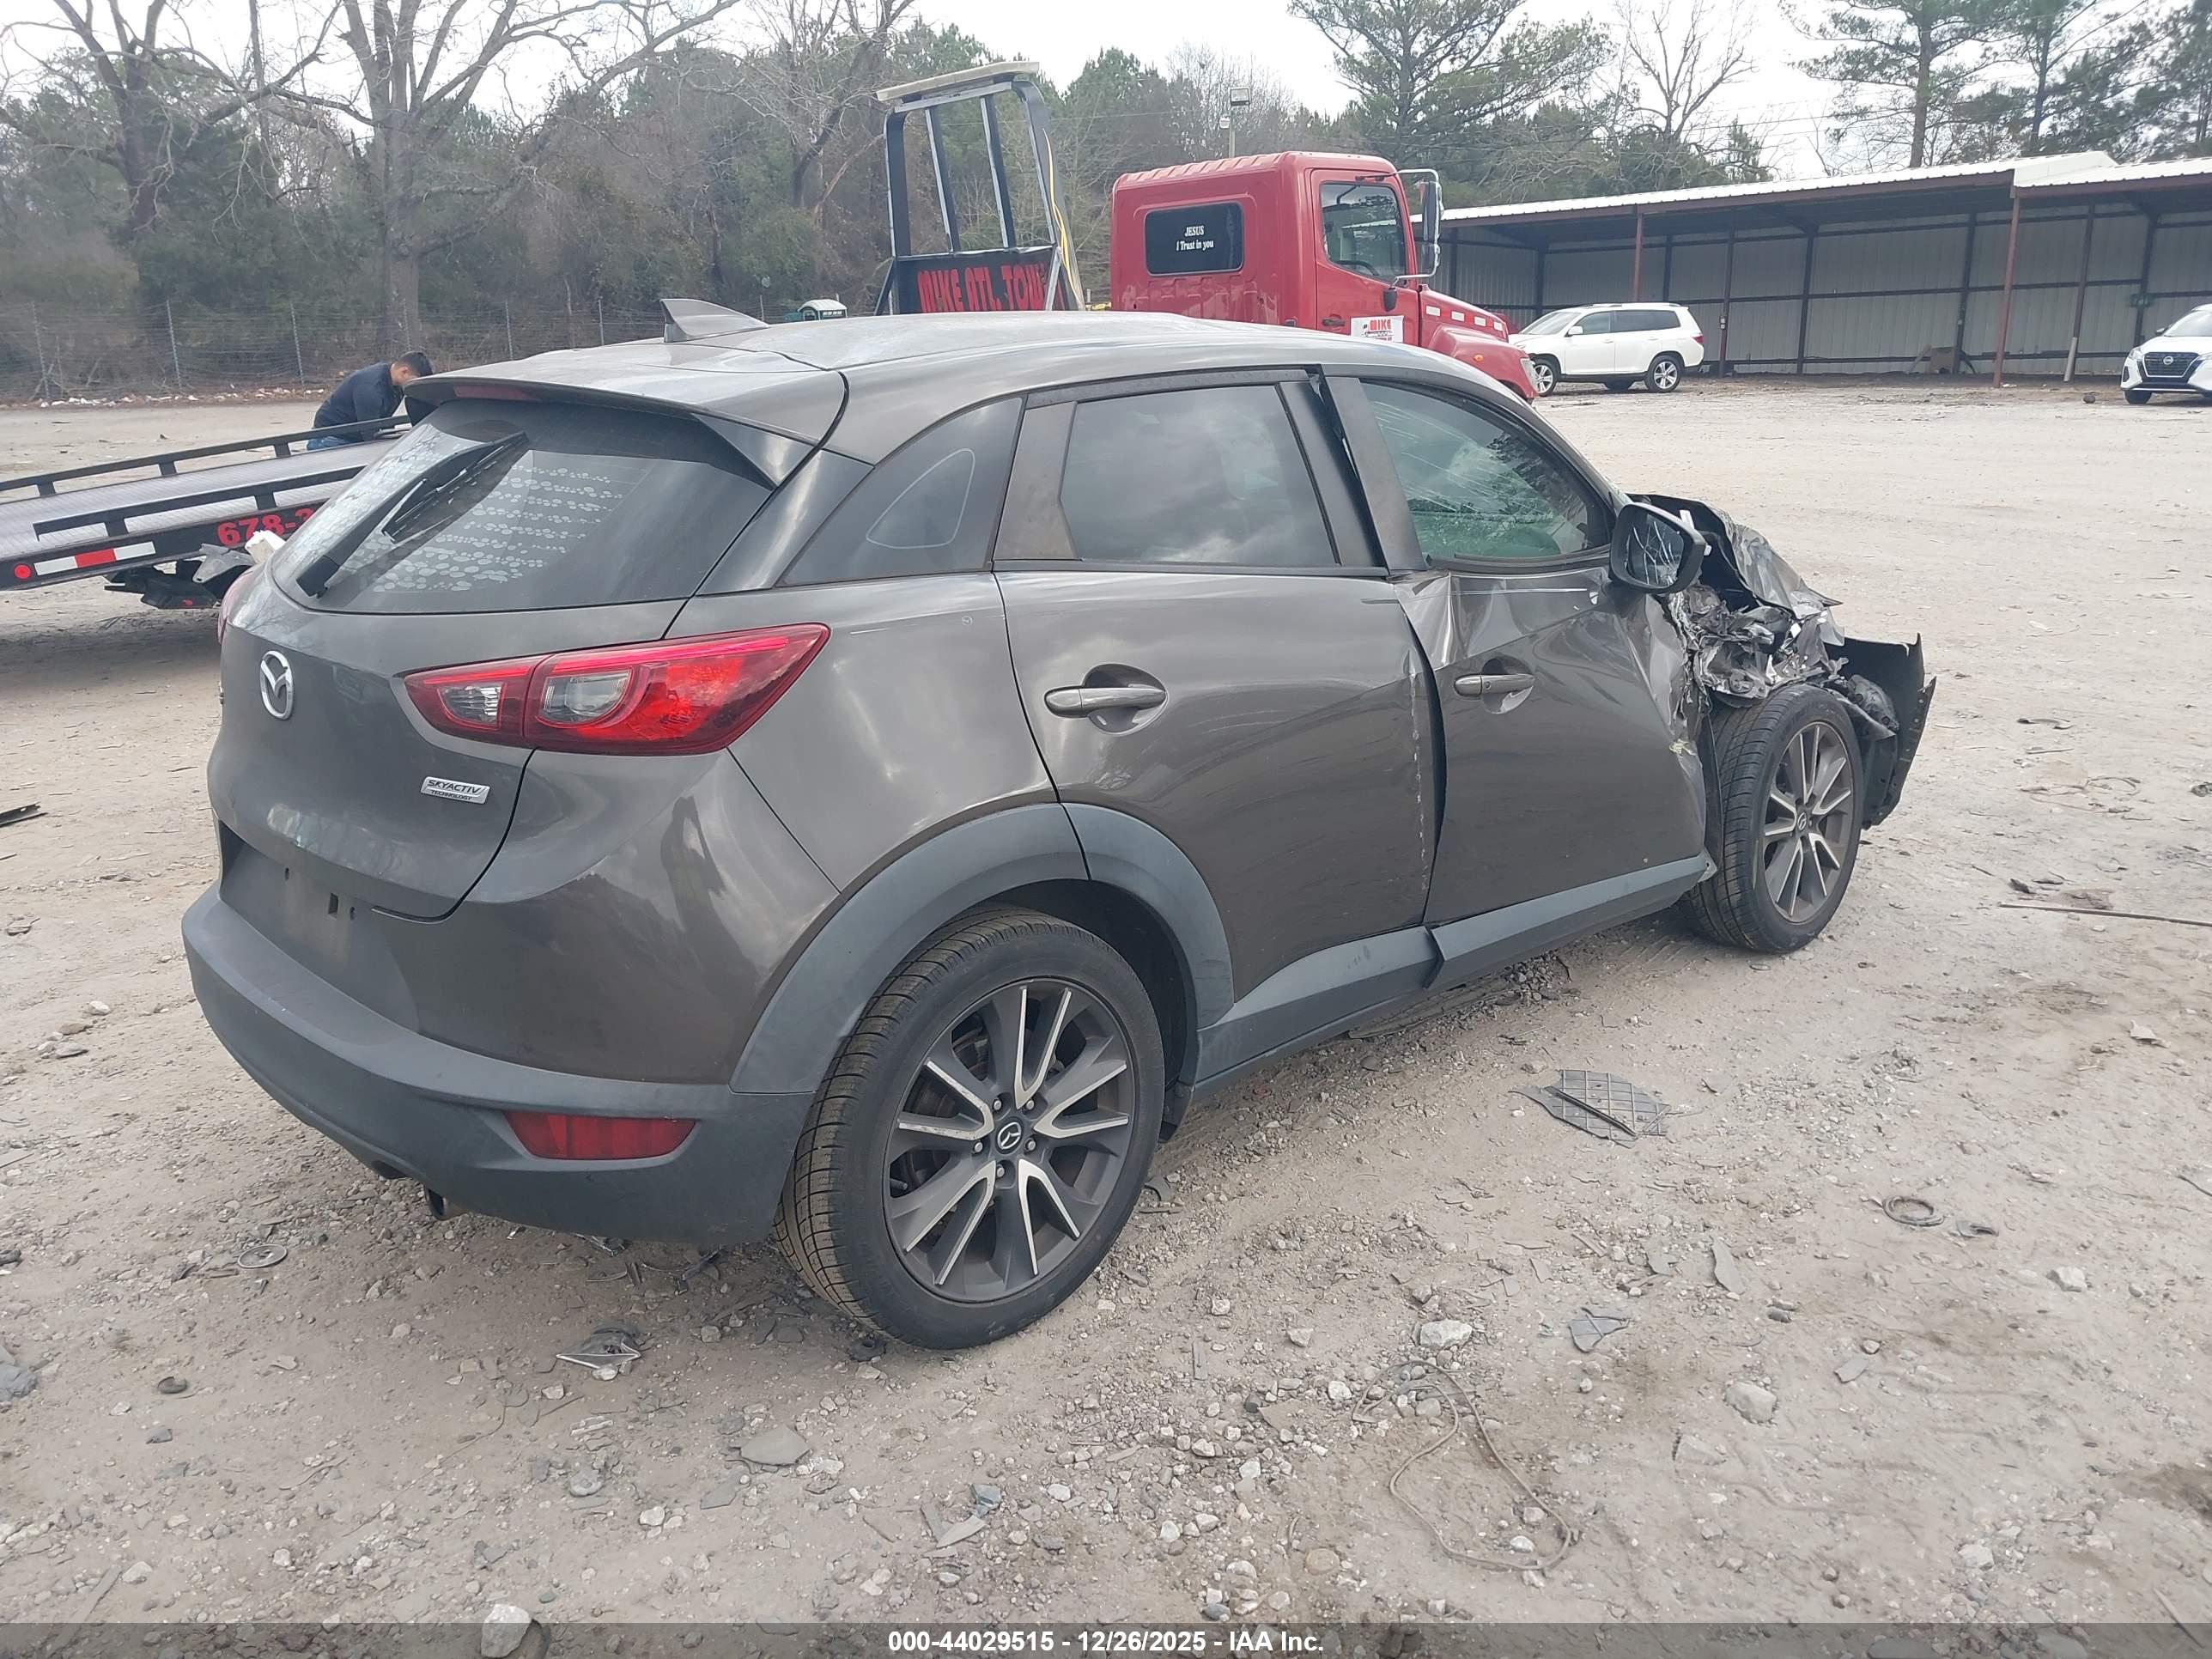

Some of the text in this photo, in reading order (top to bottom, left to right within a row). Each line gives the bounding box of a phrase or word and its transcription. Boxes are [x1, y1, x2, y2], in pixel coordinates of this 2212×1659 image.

[1184, 225, 1205, 237] JESUS
[1176, 239, 1214, 251] I Trust in you
[917, 268, 963, 313] MIKE
[1000, 263, 1066, 310] TOW
[427, 780, 482, 793] SKYACTIV
